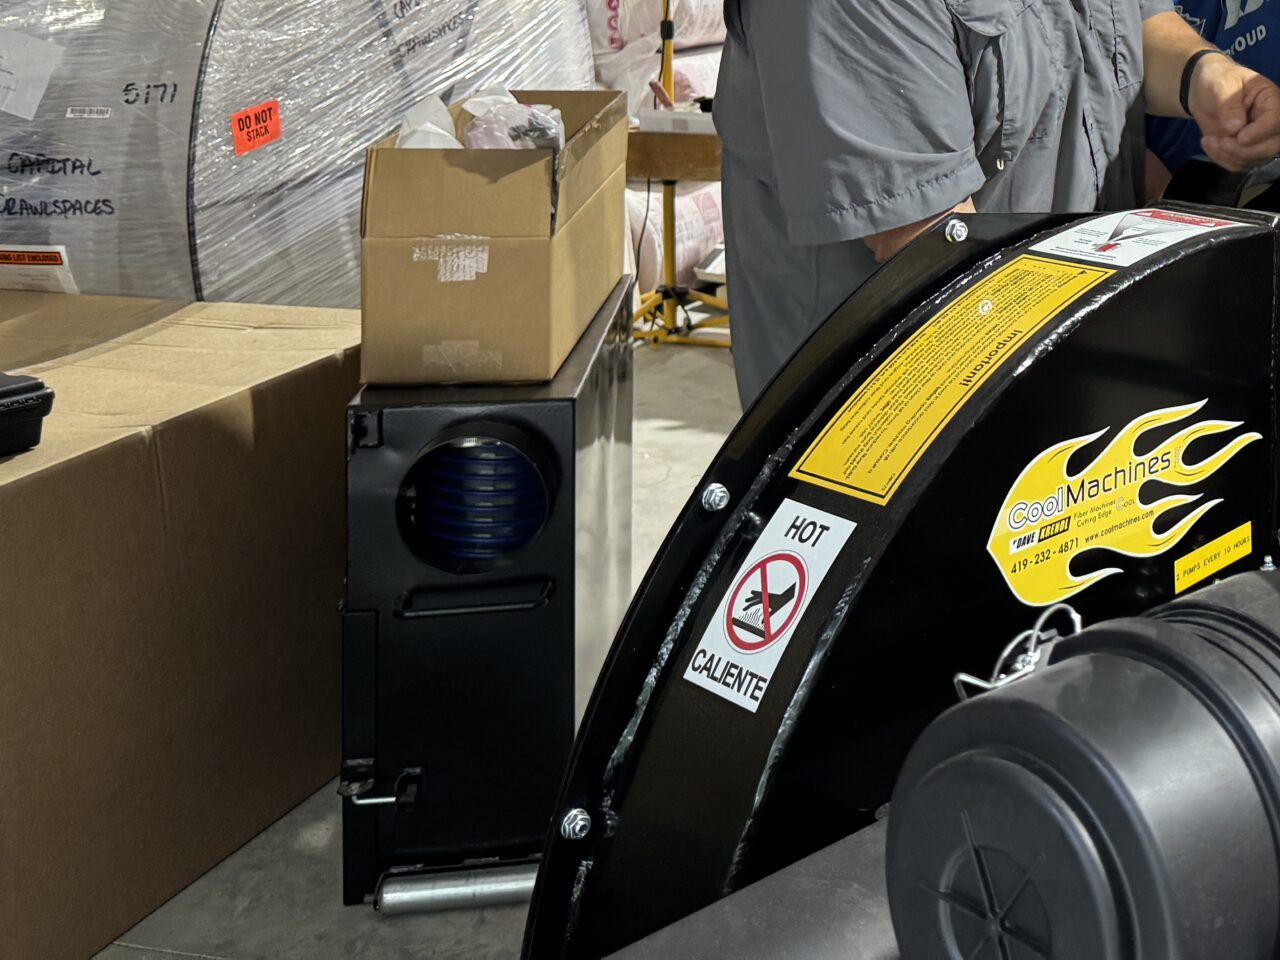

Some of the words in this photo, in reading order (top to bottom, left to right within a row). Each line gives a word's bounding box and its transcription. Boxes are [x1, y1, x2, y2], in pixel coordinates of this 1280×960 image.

[237, 115, 252, 133] DO
[254, 107, 273, 125] NOT
[246, 124, 270, 143] STACK
[959, 329, 1023, 387] Important!
[1009, 451, 1171, 529] CoolMachines
[1073, 509, 1089, 521] Fiber
[1090, 499, 1116, 515] Machines
[1076, 515, 1097, 528] Cutting
[1097, 509, 1112, 522] Edge
[1085, 509, 1155, 543] www.coolmachines.com
[784, 515, 831, 548] HOT
[1016, 531, 1036, 549] DAVE
[1040, 517, 1070, 540] KRENDL
[1183, 562, 1201, 577] PUMPS
[1203, 551, 1221, 567] EVERY
[1223, 546, 1232, 558] 10
[1233, 535, 1251, 551] HOURS
[691, 648, 768, 703] CALIENTE
